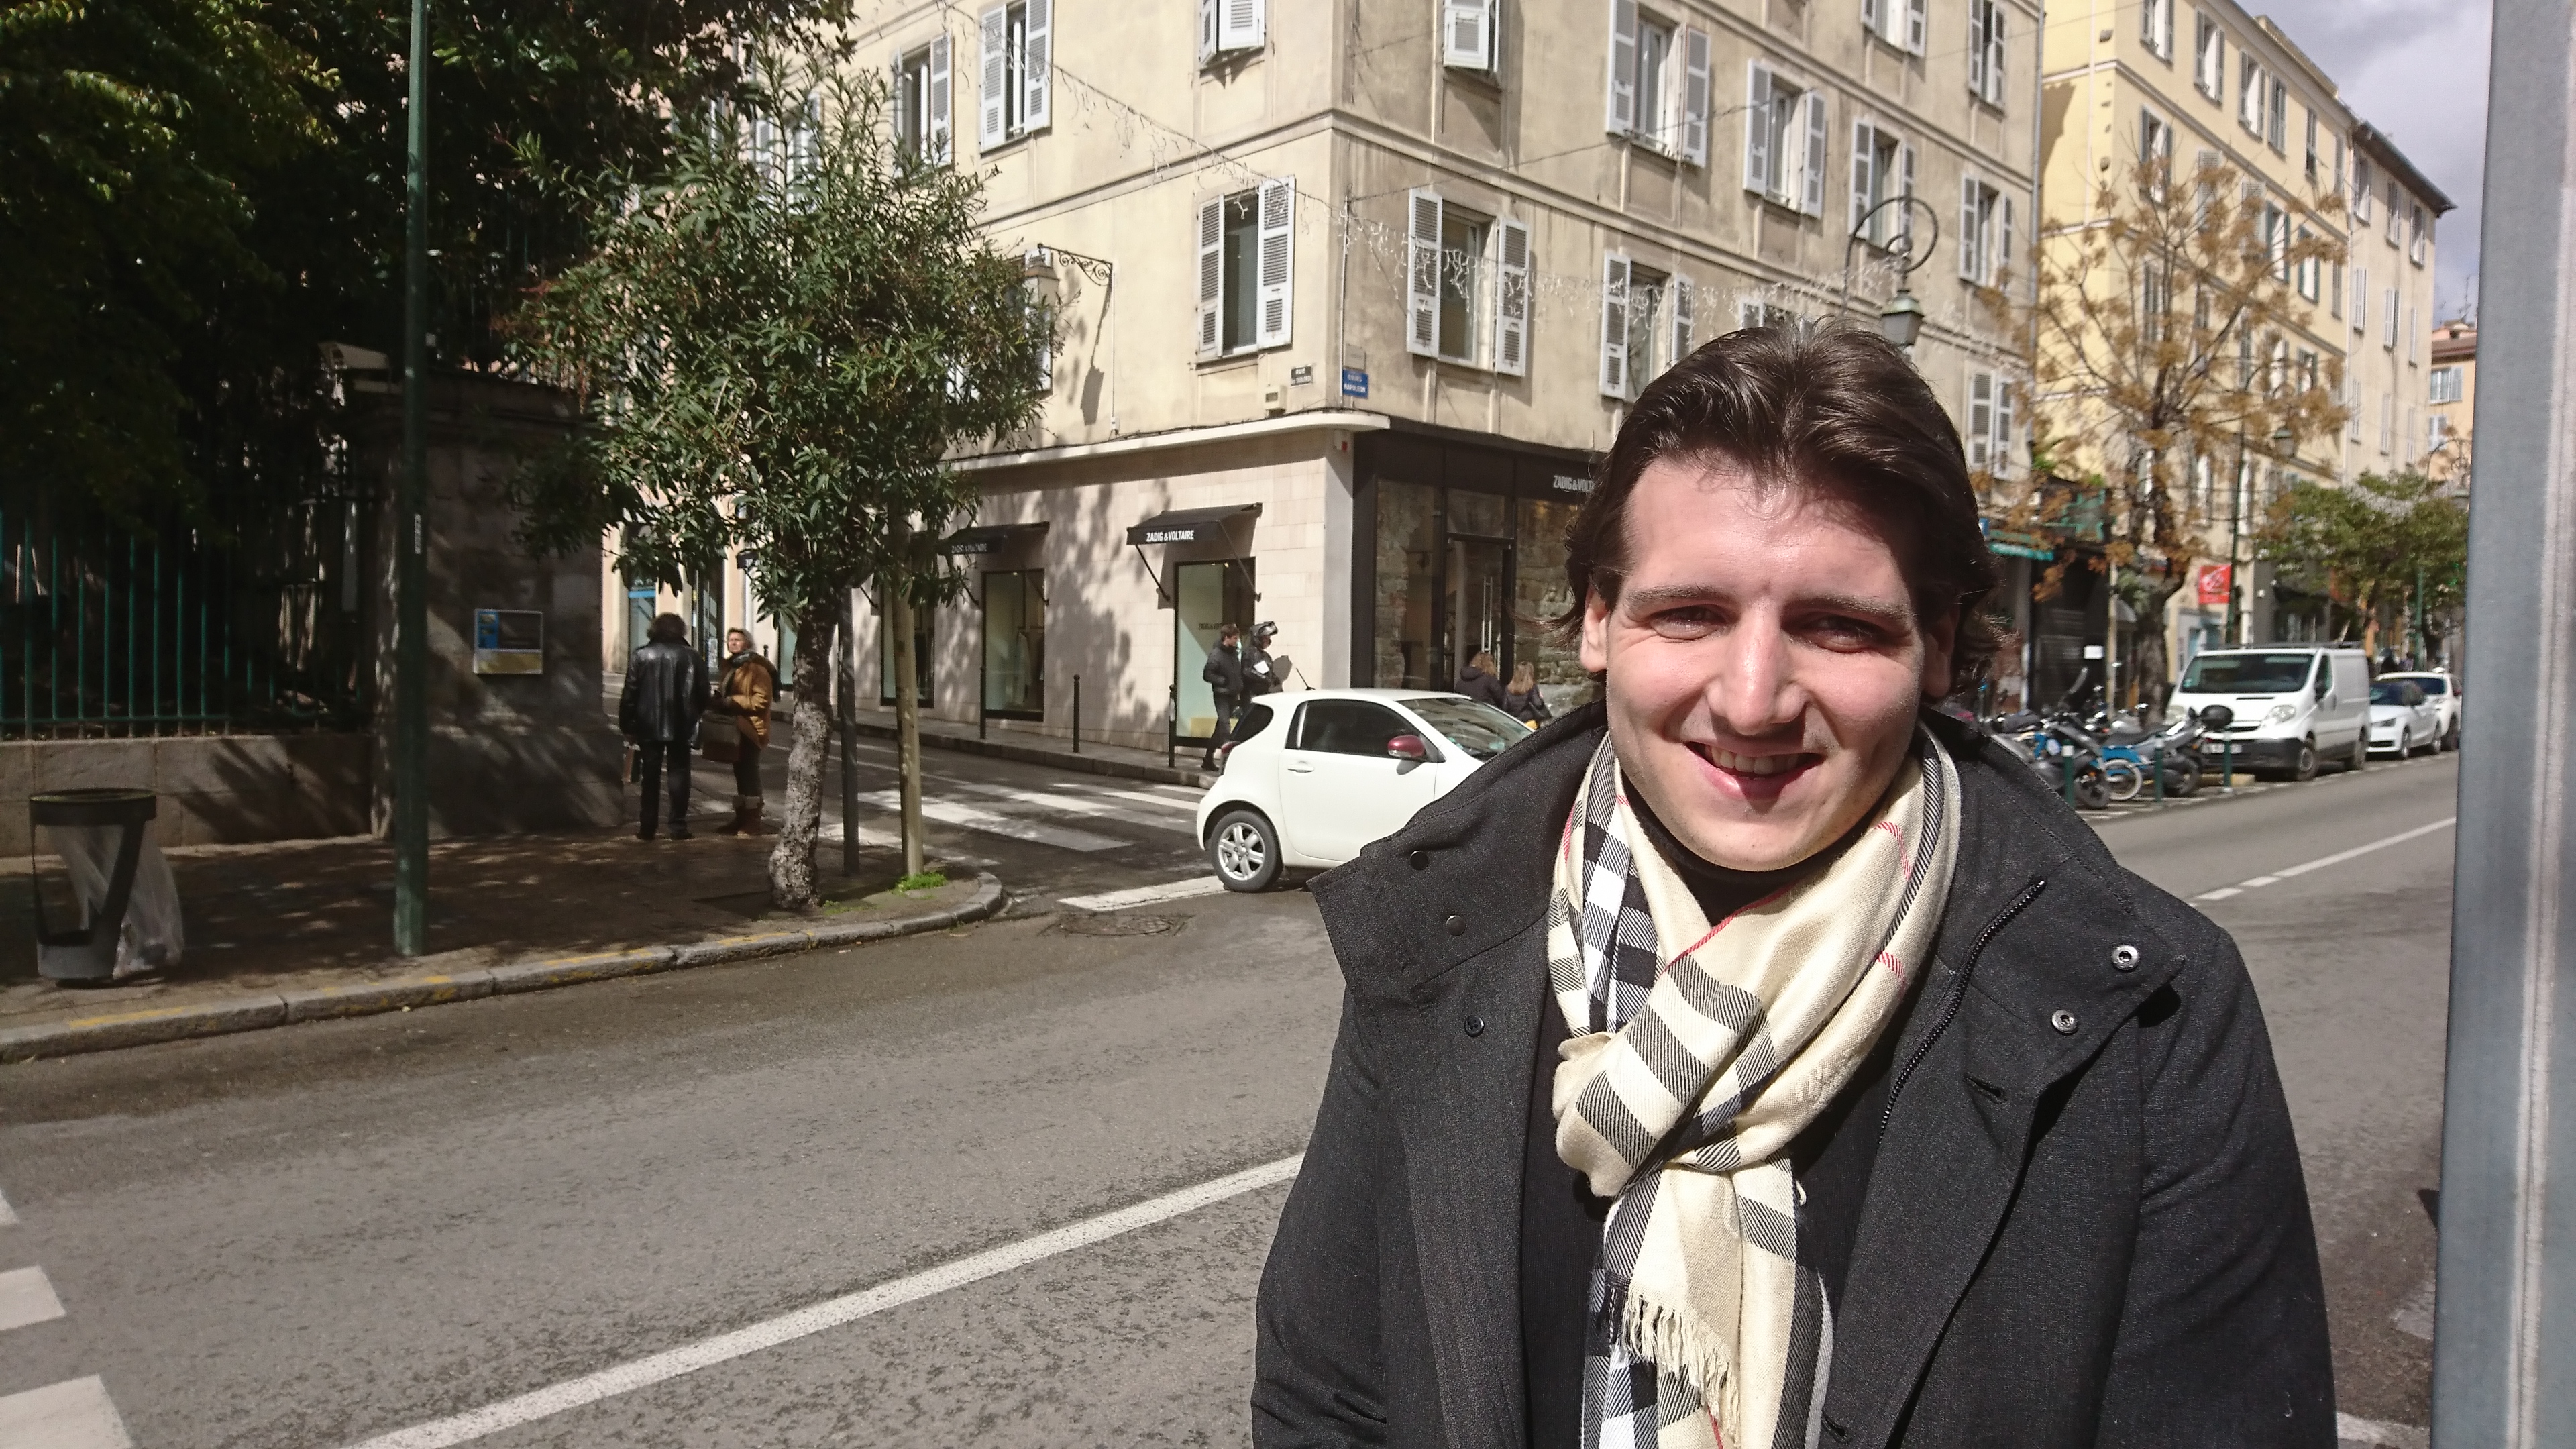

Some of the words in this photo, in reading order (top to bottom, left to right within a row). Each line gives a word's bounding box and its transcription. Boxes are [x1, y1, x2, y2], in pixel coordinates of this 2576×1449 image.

[1553, 475, 1572, 490] ZADIG
[1146, 531, 1163, 542] ZADIG
[1168, 530, 1194, 541] VOLTAIRE
